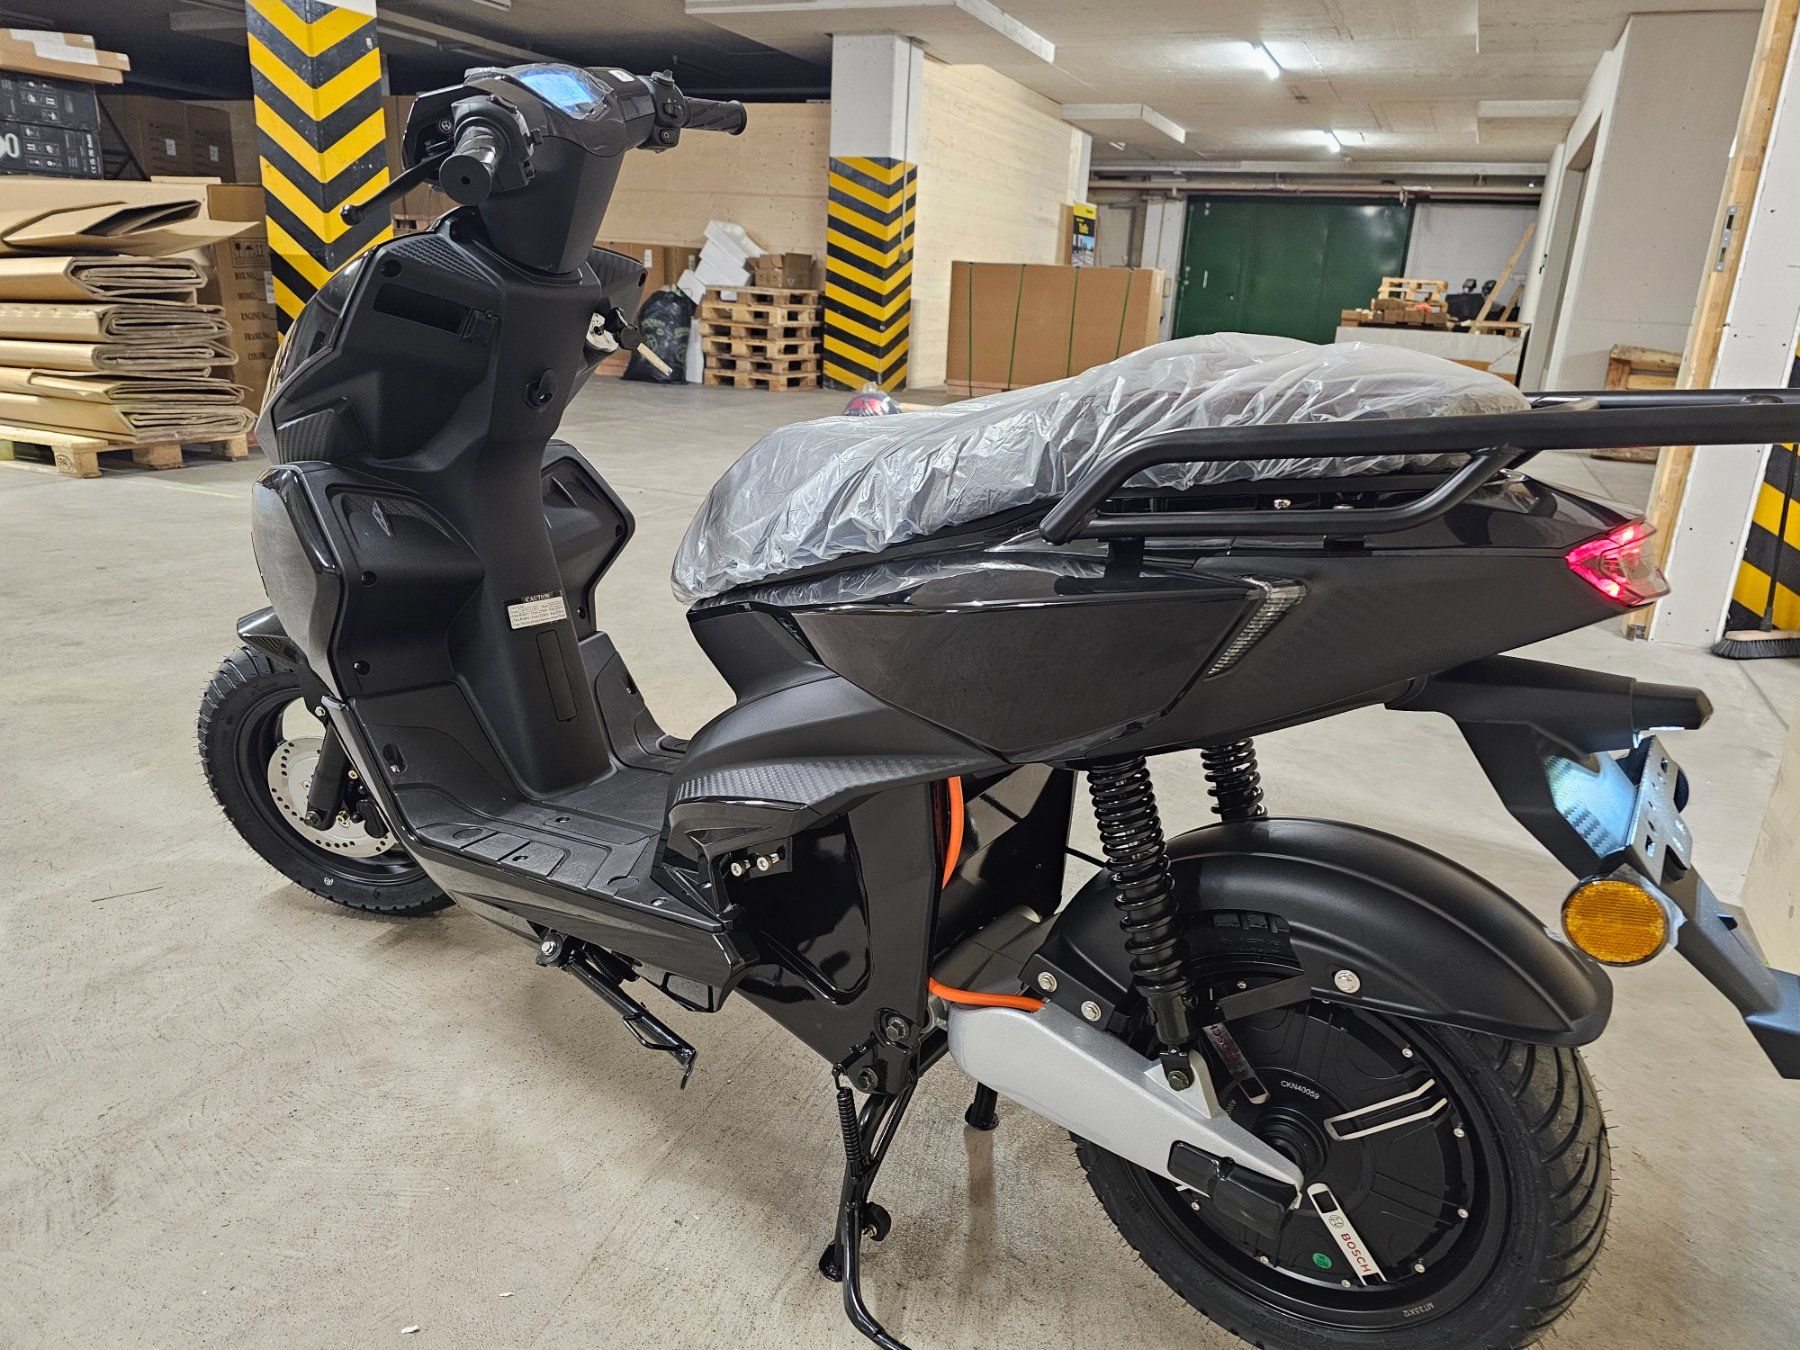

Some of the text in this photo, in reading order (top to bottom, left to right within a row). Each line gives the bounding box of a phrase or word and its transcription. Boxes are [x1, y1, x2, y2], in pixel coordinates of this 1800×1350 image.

[525, 593, 551, 603] CAUTION
[1280, 1080, 1320, 1100] CKN40059
[1341, 1232, 1372, 1273] BOSCH
